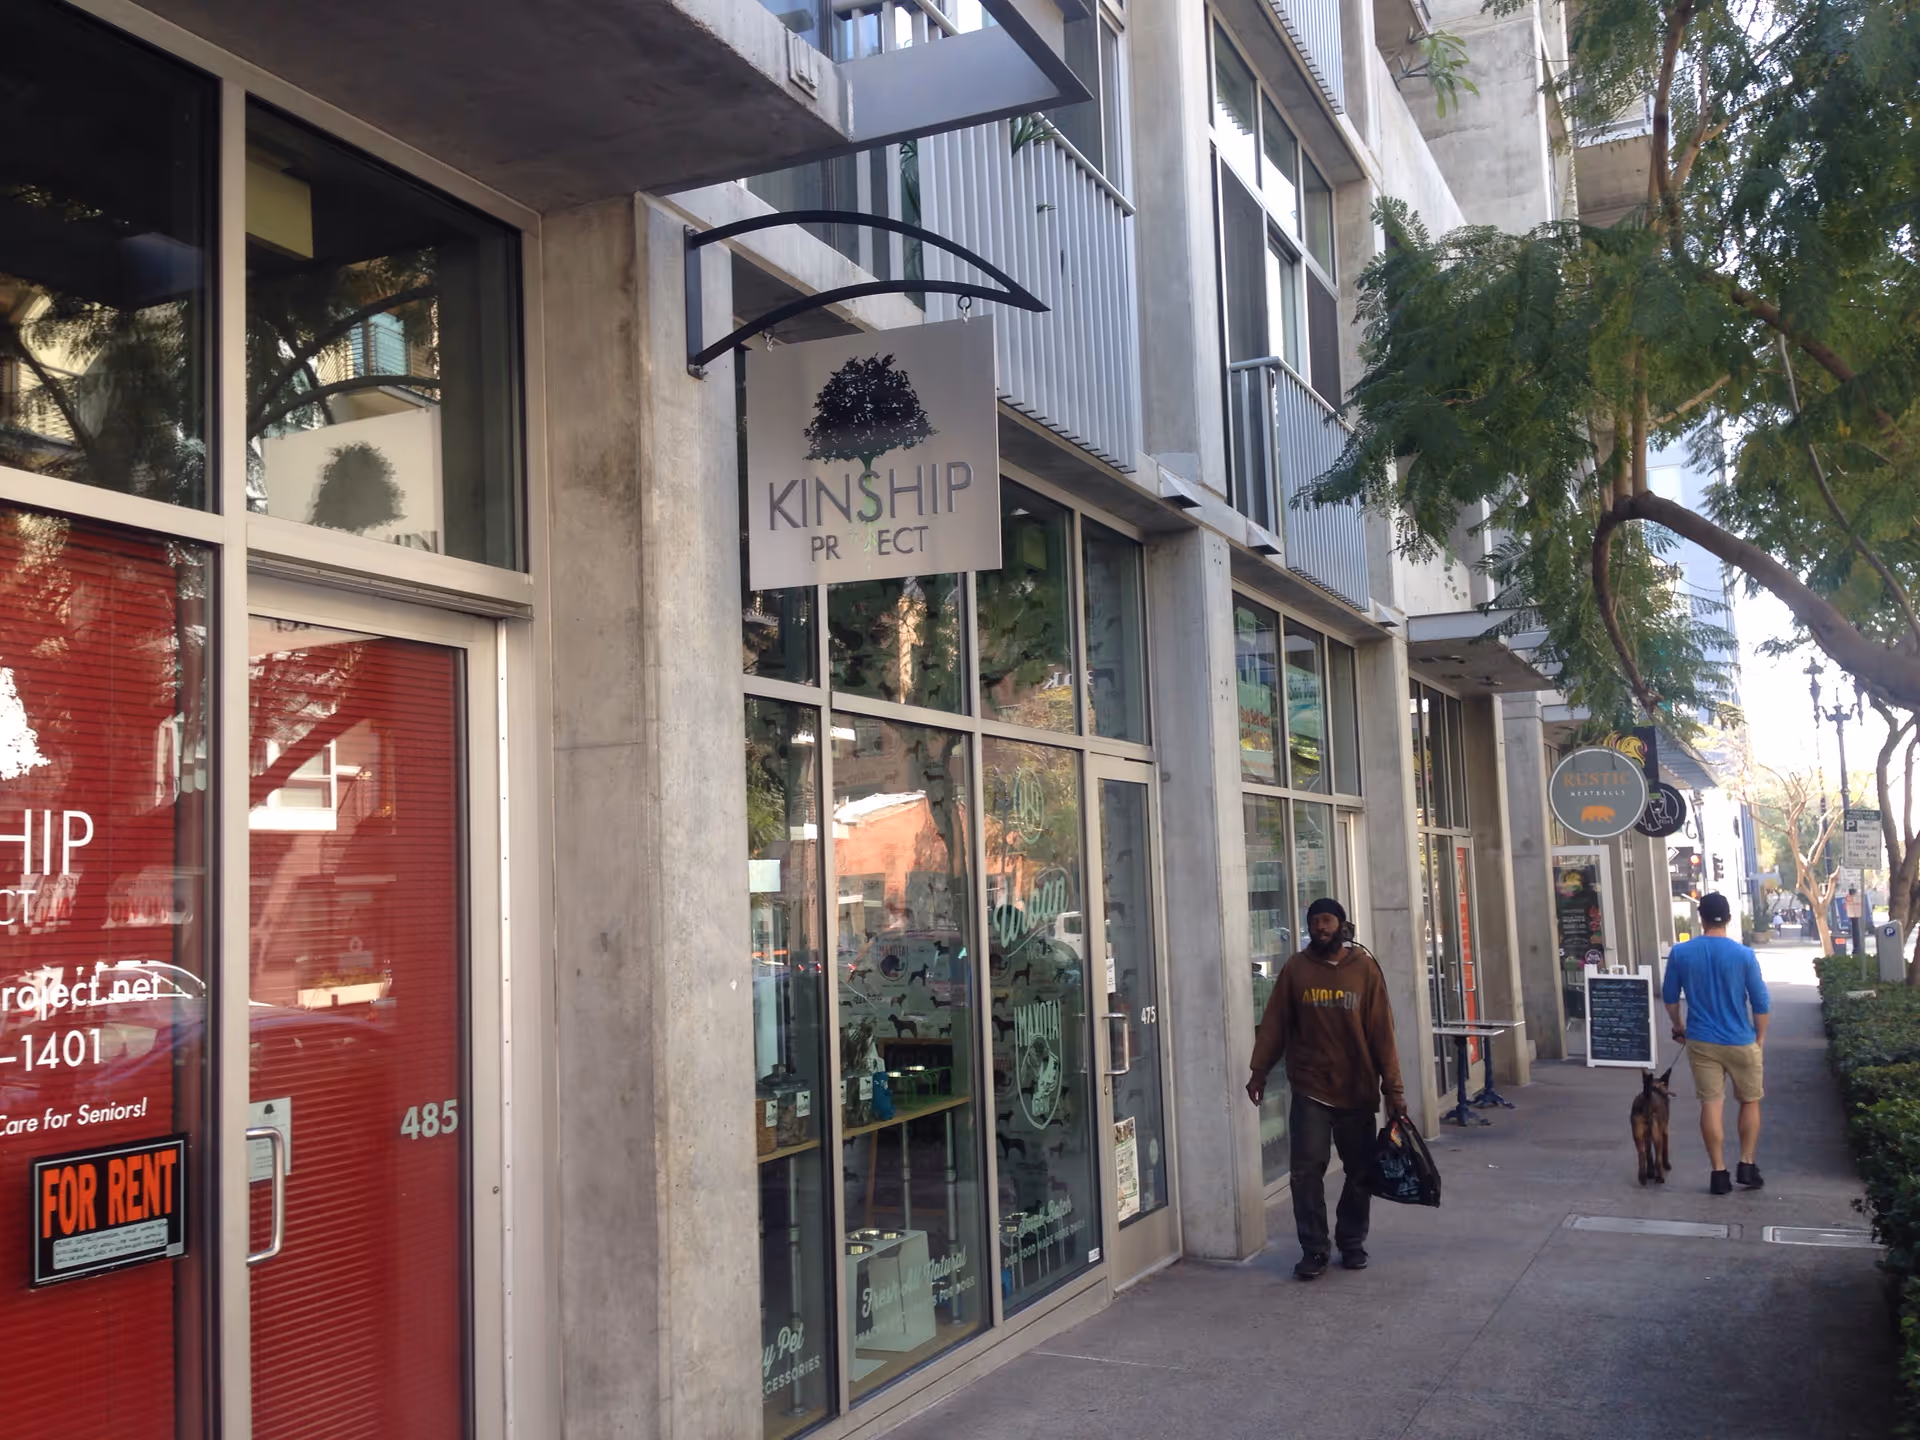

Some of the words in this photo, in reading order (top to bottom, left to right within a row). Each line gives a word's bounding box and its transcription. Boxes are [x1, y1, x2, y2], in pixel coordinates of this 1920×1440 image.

[768, 461, 974, 531] KINSHIP
[811, 525, 928, 561] PRECT
[1563, 769, 1631, 788] RUSTIC
[1570, 789, 1626, 797] MEATBALLS
[1141, 1006, 1156, 1024] 475
[0, 1115, 38, 1136] Care
[43, 1107, 72, 1130] for
[77, 1096, 148, 1126] Seniors!
[401, 1098, 459, 1140] 485
[42, 1163, 97, 1239] FOR
[108, 1149, 177, 1226] RENT
[778, 1321, 804, 1360] Pet
[763, 1354, 820, 1397] CESSORIES
